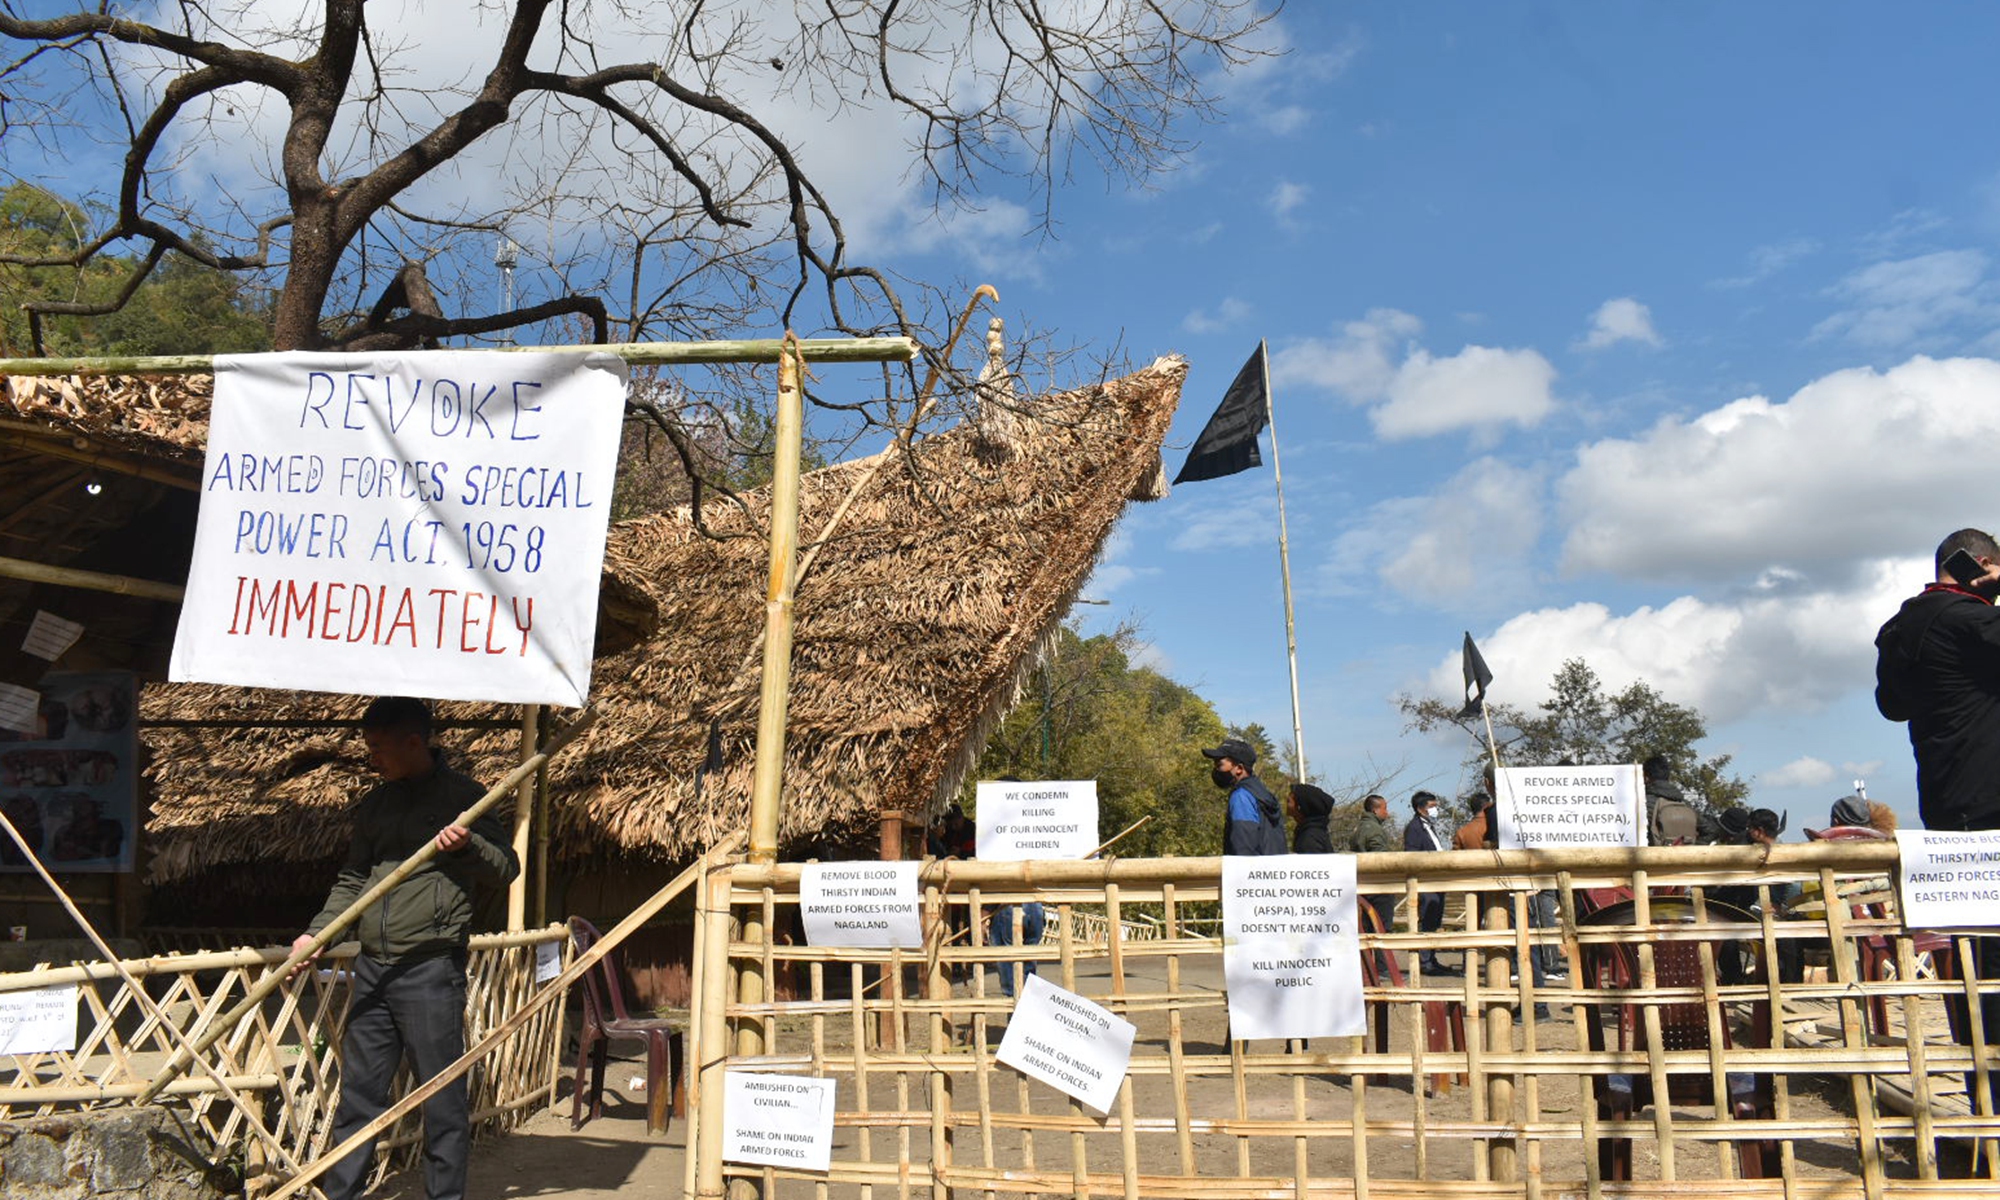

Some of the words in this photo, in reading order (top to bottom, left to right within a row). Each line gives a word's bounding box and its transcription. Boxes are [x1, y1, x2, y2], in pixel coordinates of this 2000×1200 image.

[300, 371, 542, 441] REVOKE
[208, 453, 324, 494] ARMED
[339, 456, 450, 502] FORCES
[461, 464, 593, 509] SPECIAL
[234, 510, 349, 560] POWER
[461, 520, 546, 574] 1958
[227, 575, 534, 657] IMMEDIATELY
[1524, 777, 1569, 787] REVOKE
[1572, 777, 1615, 787] ARMED
[1005, 792, 1020, 801] WE
[1022, 791, 1069, 801] CONDEMN
[1525, 795, 1568, 805] FORCES
[1571, 795, 1616, 805] SPECIAL
[1022, 808, 1055, 817] KILLING
[1512, 813, 1554, 824] POWER
[1557, 813, 1579, 824] ACT
[1582, 813, 1631, 826] (AFSPA),
[995, 825, 1008, 835] OF
[1010, 825, 1031, 834] OUR
[1032, 824, 1079, 834] INNOCENT
[1515, 832, 1543, 843] 1958
[1545, 832, 1629, 843] IMMEDIATELY.
[1924, 836, 1977, 845] REMOVE
[1015, 840, 1060, 849] CHILDREN
[821, 872, 861, 880] REMOVE
[864, 870, 897, 880] BLOOD
[1247, 871, 1287, 880] ARMED
[1290, 871, 1330, 880] FORCES
[1909, 871, 1955, 883] ARMED
[1957, 870, 2000, 882] FORCES
[821, 888, 860, 897] THIRSTY
[861, 887, 897, 896] INDIAN
[1236, 889, 1277, 898] SPECIAL
[1280, 889, 1320, 898] POWER
[1322, 889, 1343, 898] ACT
[1915, 891, 1969, 903] EASTERN
[1972, 889, 2000, 901] NAG
[808, 905, 843, 914] ARMED
[844, 905, 881, 914] FORCES
[883, 904, 912, 913] FROM
[1253, 906, 1298, 917] (AFSPA),
[1301, 906, 1327, 916] 1958
[834, 921, 889, 930] NAGALAND
[1241, 924, 1287, 933] DOESN'T
[1290, 924, 1323, 933] MEAN
[1325, 924, 1340, 934] TO
[1252, 961, 1274, 971] KILL
[1277, 958, 1332, 969] INNOCENT
[1275, 977, 1313, 988] PUBLIC
[1049, 994, 1097, 1022] AMBUSHED
[1097, 1016, 1111, 1030] ON
[1024, 1036, 1056, 1057] SHAME
[1056, 1052, 1072, 1065] ON
[1071, 1059, 1103, 1081] INDIAN
[1022, 1054, 1056, 1075] ARMED
[745, 1081, 794, 1094] AMBUSHED
[795, 1085, 809, 1095] ON
[736, 1129, 766, 1141] SHAME
[767, 1131, 782, 1142] ON
[783, 1133, 814, 1145] INDIAN
[740, 1145, 772, 1156] ARMED
